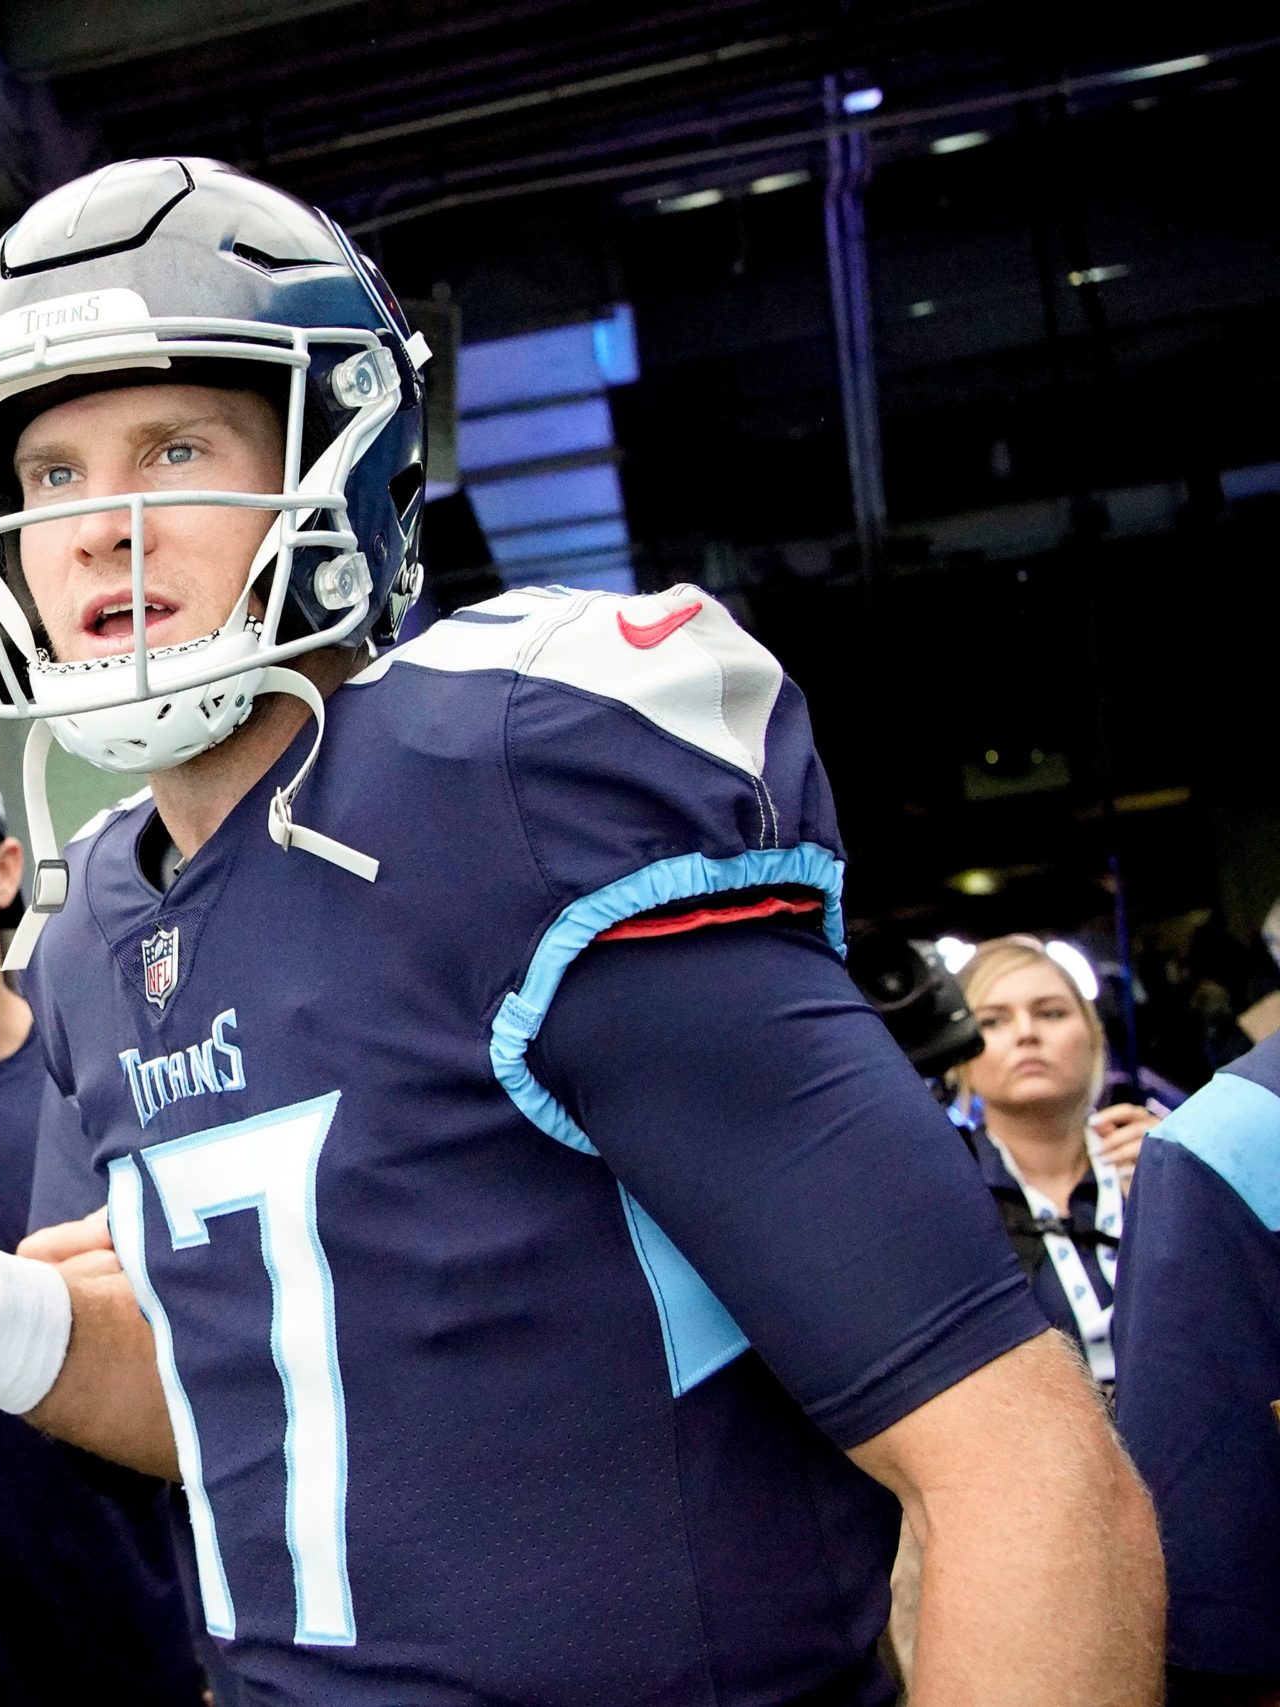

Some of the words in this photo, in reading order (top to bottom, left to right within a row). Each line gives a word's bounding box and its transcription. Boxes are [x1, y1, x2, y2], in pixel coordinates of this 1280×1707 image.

[21, 296, 100, 335] TITANS
[148, 960, 170, 993] NFL
[119, 1008, 247, 1129] TITANS
[107, 1089, 356, 1646] 17
